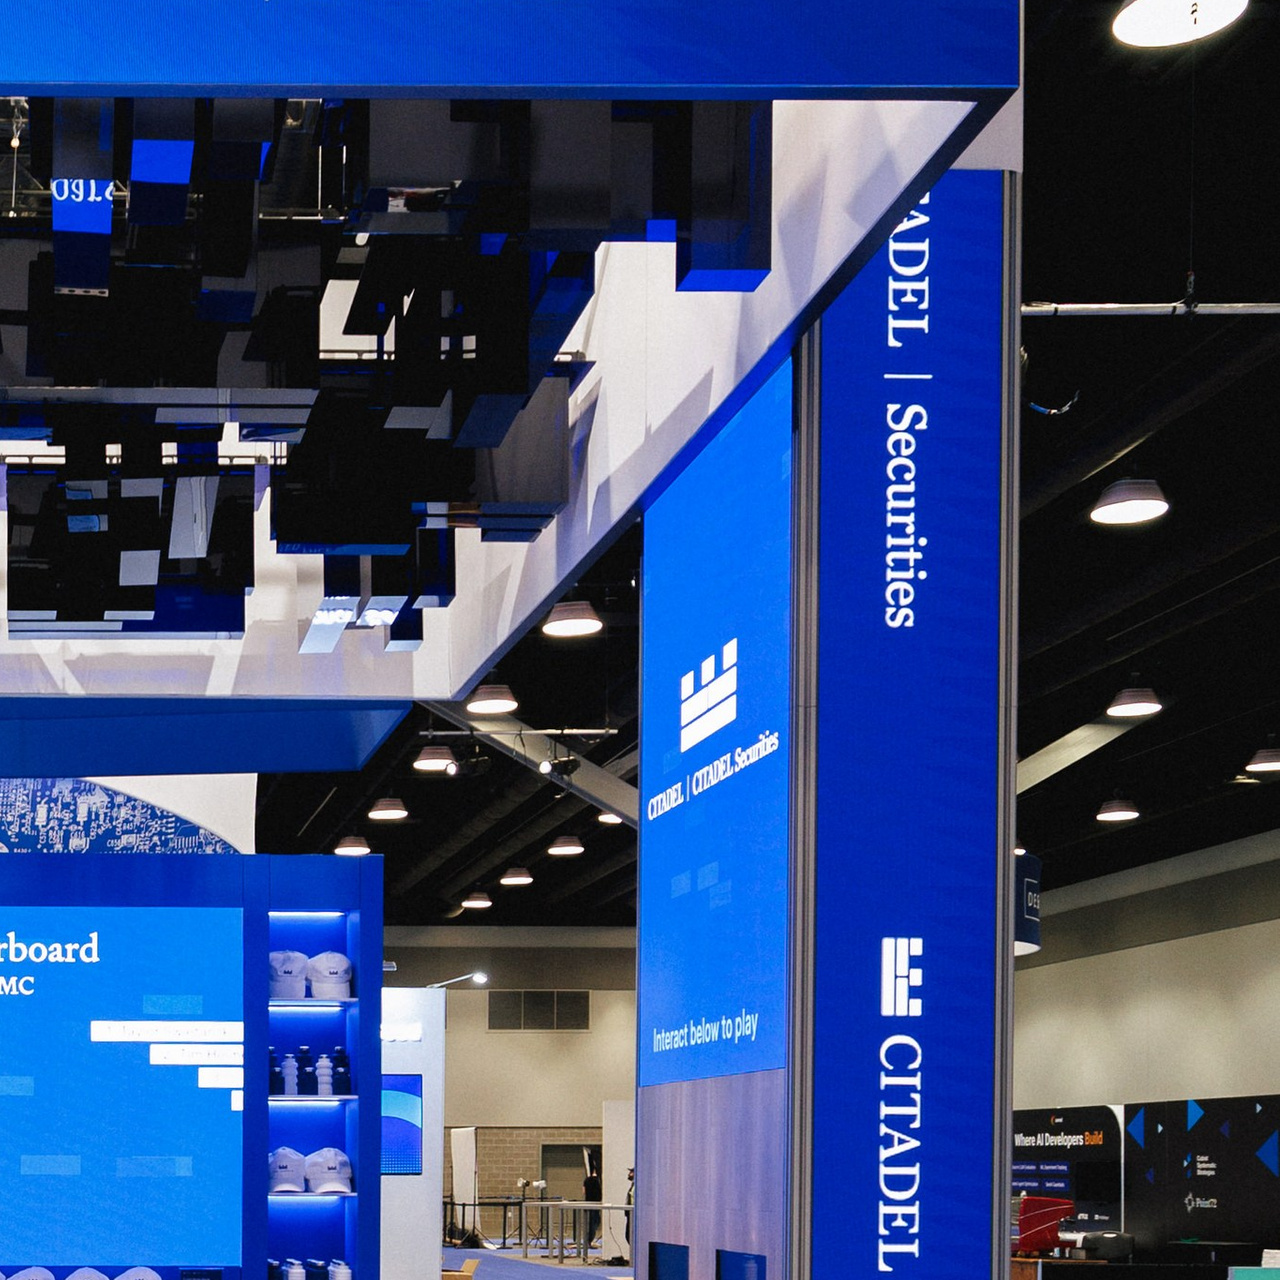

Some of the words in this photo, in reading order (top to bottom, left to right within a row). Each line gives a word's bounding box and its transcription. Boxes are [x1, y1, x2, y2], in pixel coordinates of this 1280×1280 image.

[884, 403, 928, 629] Securities
[647, 781, 685, 821] CITADEL
[692, 752, 734, 796] CITADEL
[734, 729, 780, 773] Securities
[653, 1026, 689, 1053] Interact
[690, 1018, 720, 1046] below
[721, 1014, 733, 1040] to
[734, 1007, 759, 1044] play
[877, 1034, 923, 1272] CITADEL
[1014, 1132, 1036, 1147] Where
[1036, 1132, 1045, 1147] AI
[1044, 1131, 1084, 1149] Developers
[1084, 1130, 1104, 1146] Build
